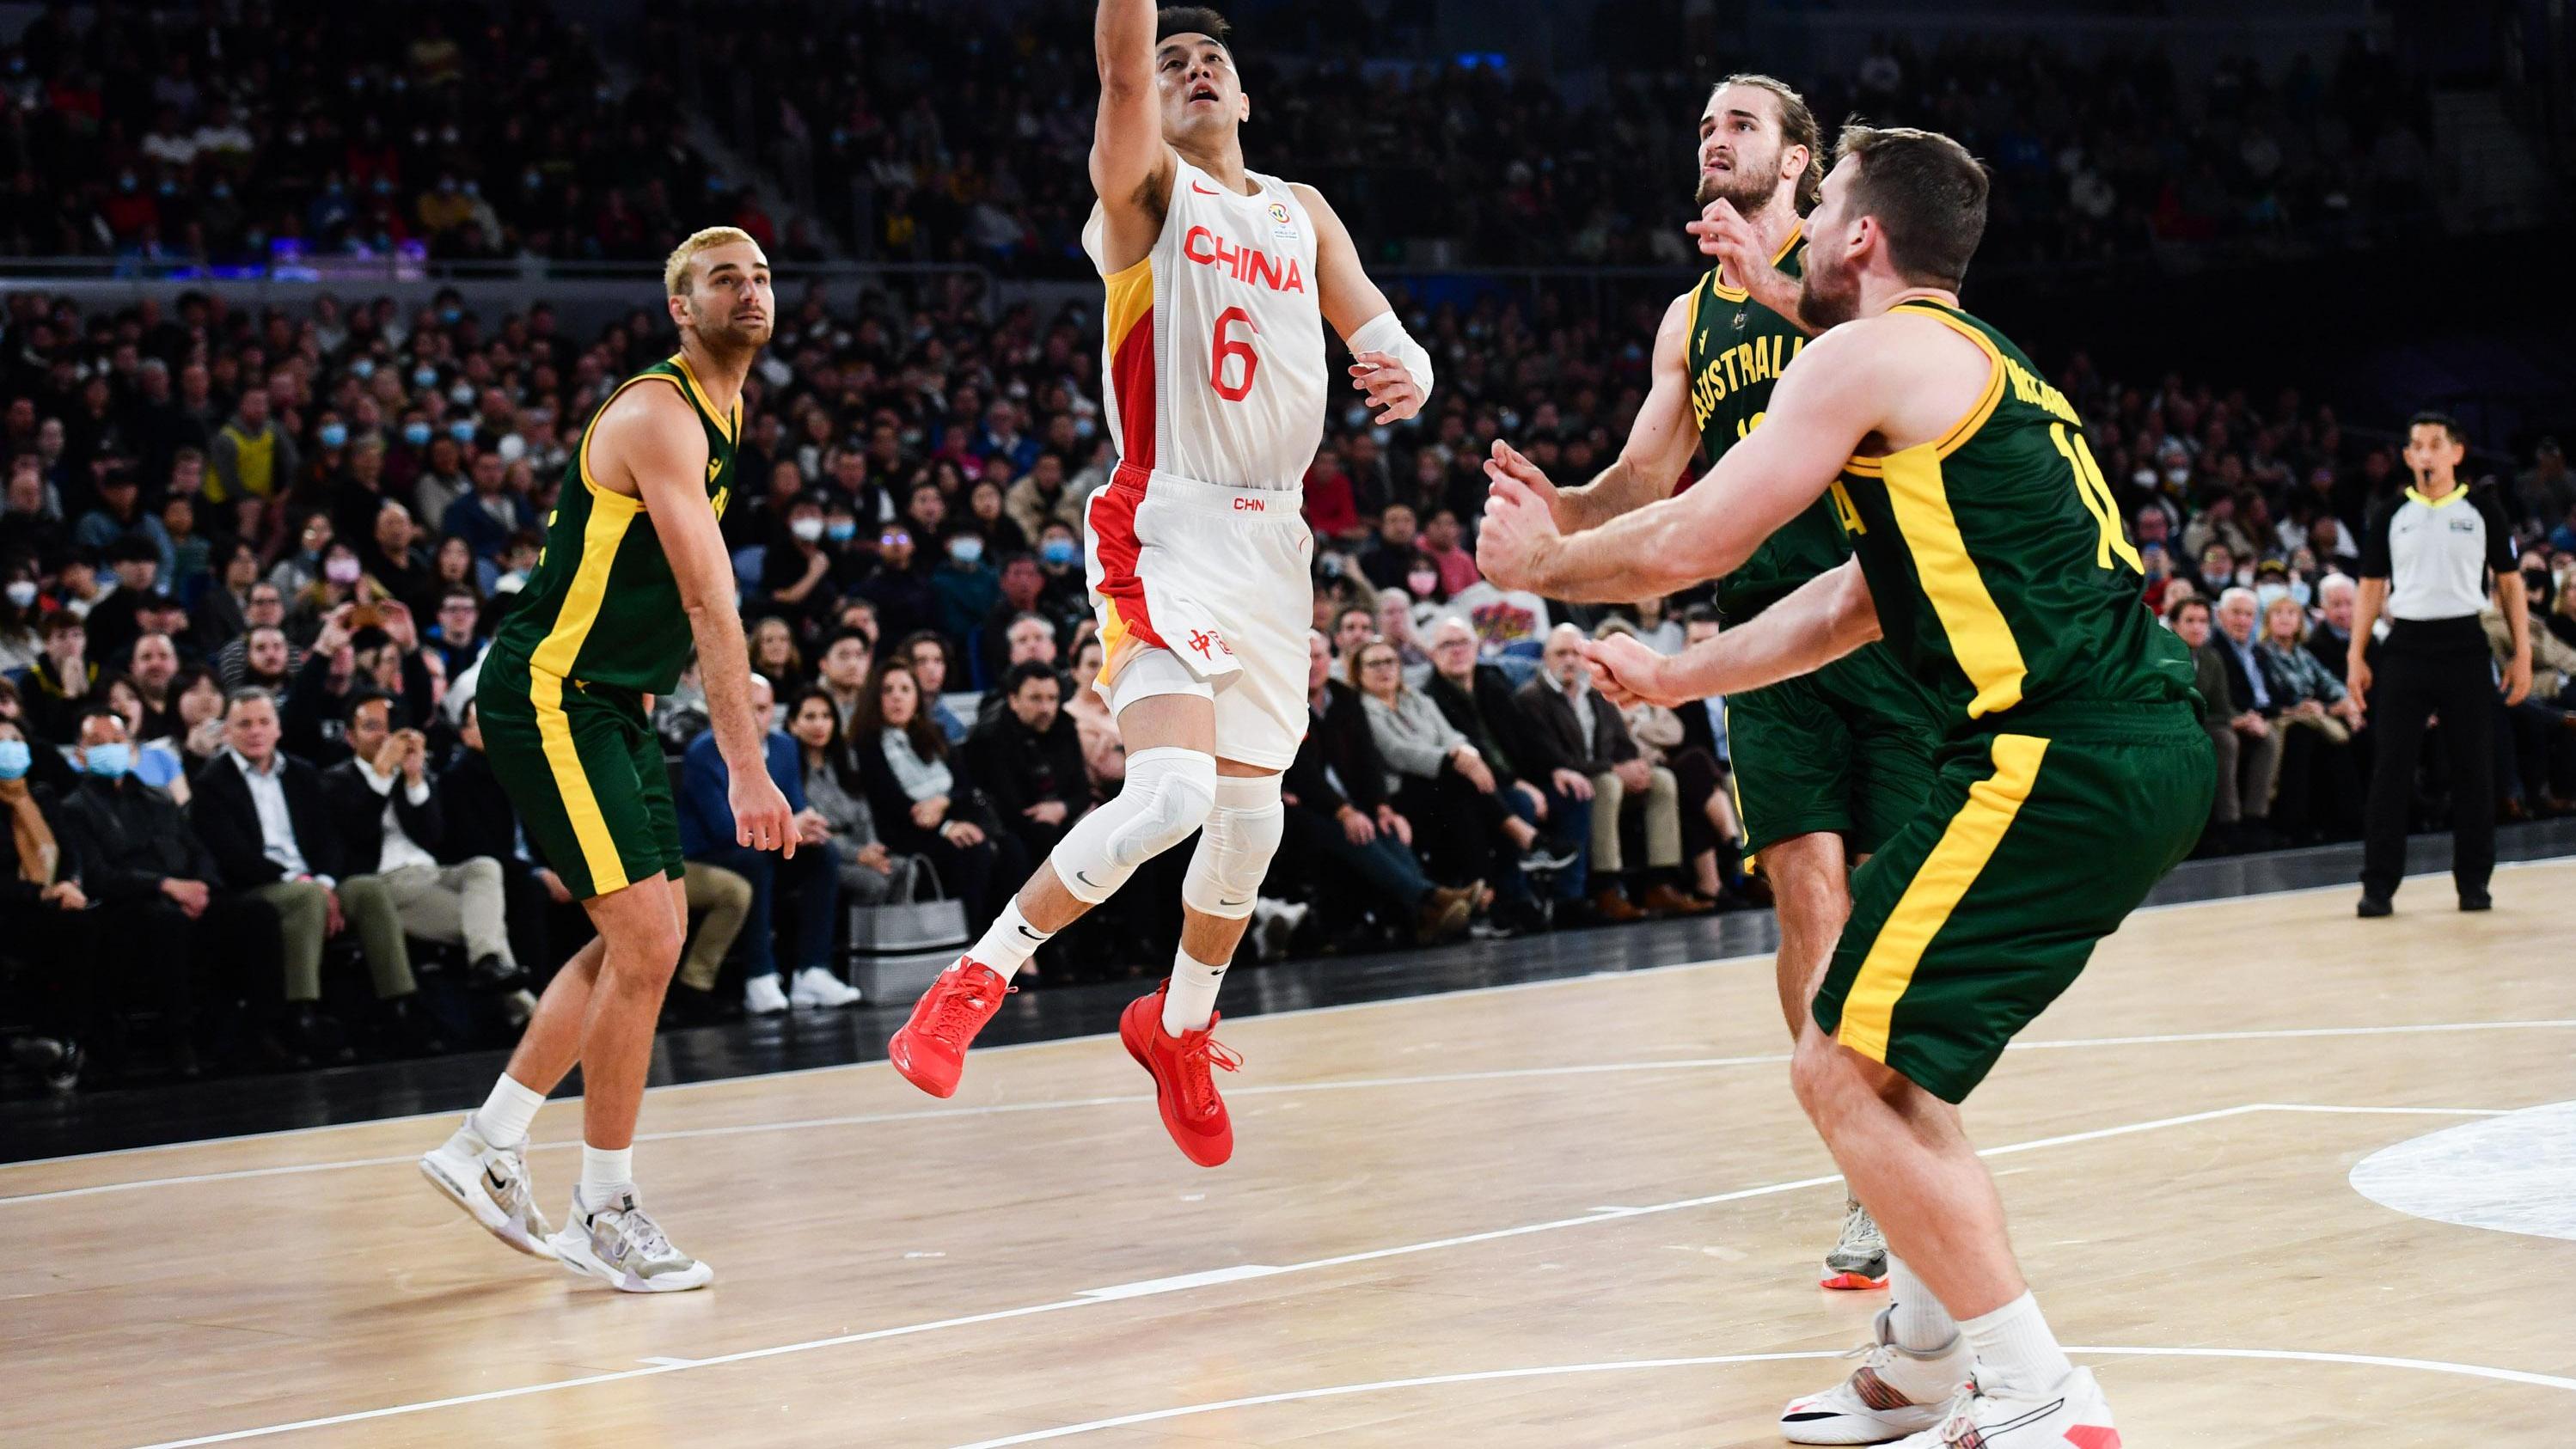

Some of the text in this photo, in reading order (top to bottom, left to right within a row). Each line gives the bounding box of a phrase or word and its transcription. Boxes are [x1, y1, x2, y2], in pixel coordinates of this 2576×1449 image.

[1184, 225, 1305, 294] CHINA
[1210, 306, 1259, 402] 6
[1233, 498, 1265, 511] CHN
